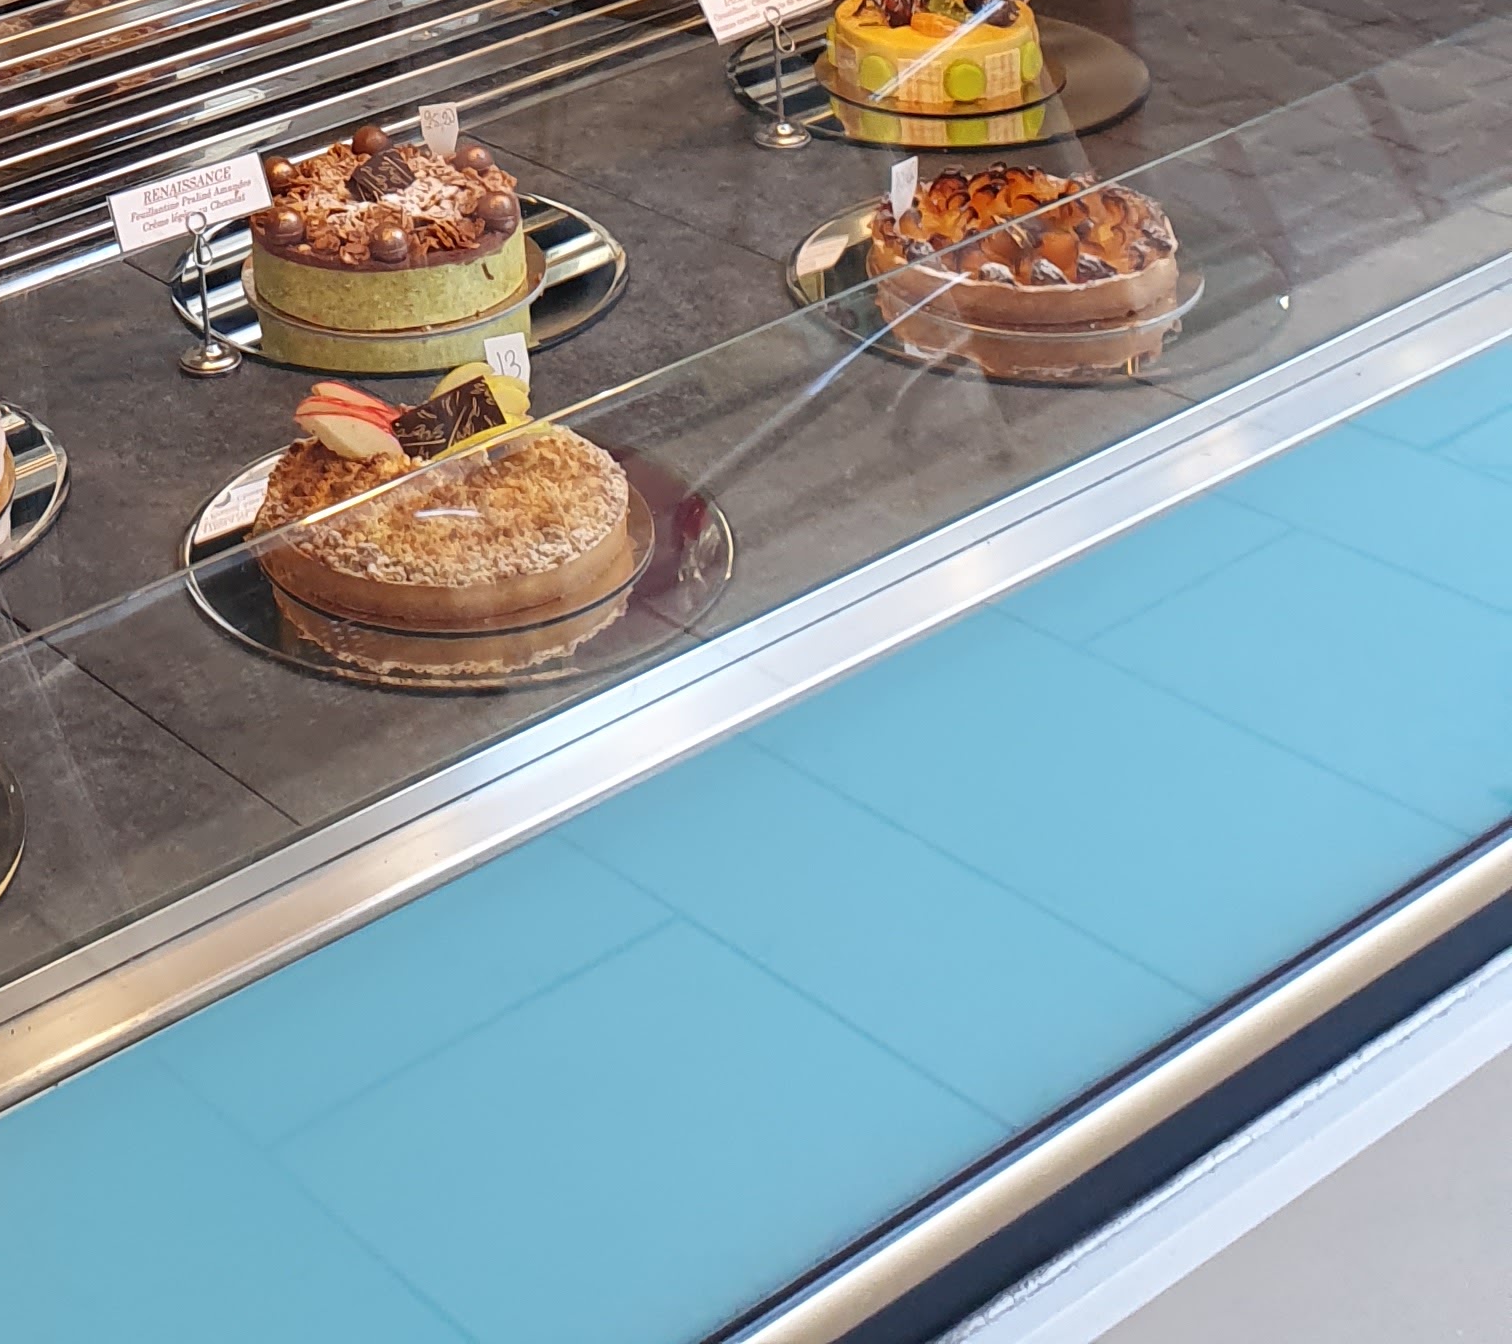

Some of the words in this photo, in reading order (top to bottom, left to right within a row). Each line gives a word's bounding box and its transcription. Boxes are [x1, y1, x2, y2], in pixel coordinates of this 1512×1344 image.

[143, 165, 232, 206] RENAISSANCE
[142, 217, 169, 233] Crème
[210, 192, 247, 211] Chocolat
